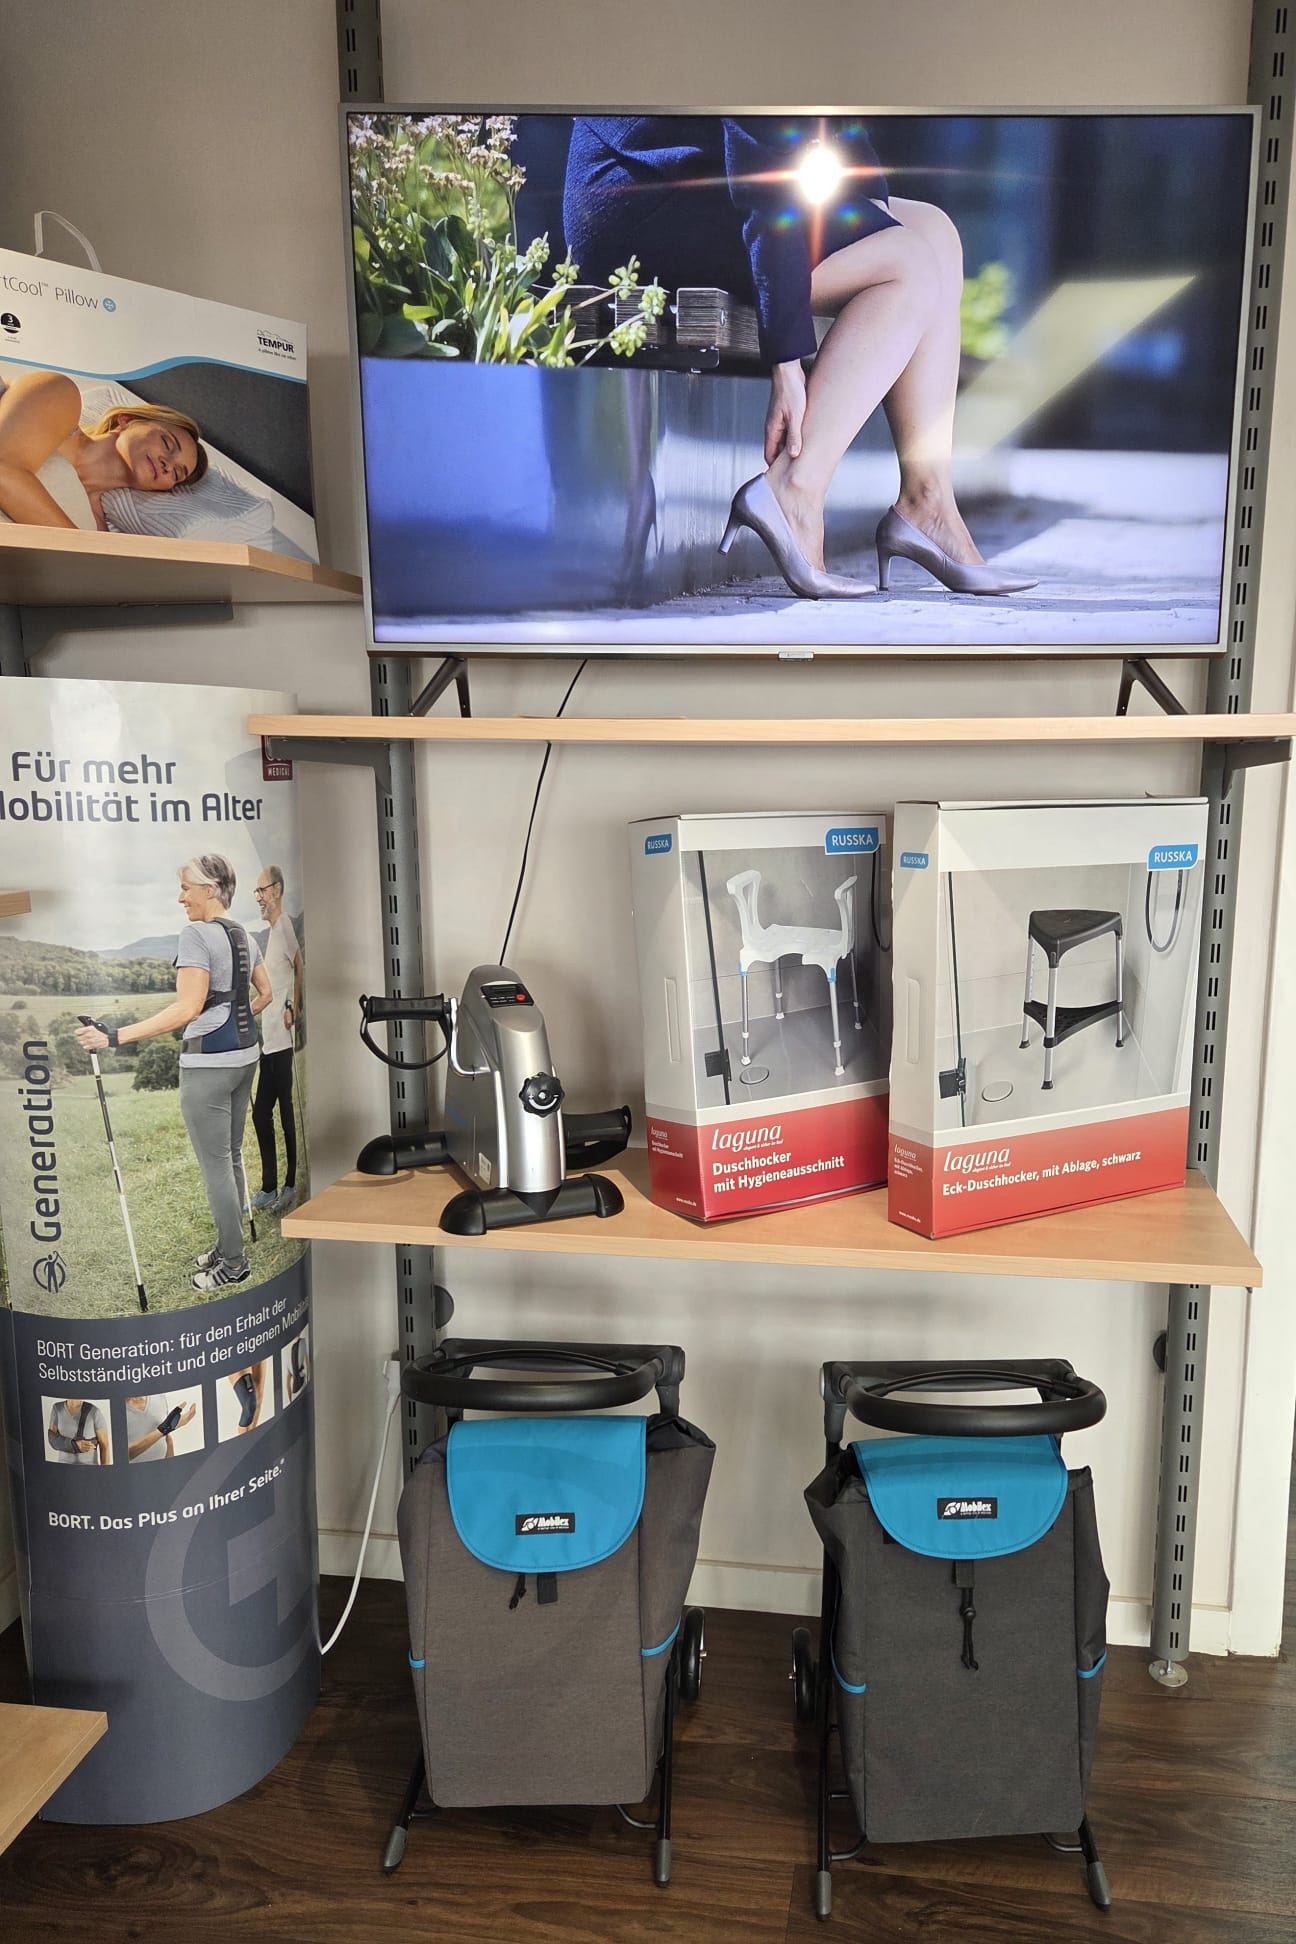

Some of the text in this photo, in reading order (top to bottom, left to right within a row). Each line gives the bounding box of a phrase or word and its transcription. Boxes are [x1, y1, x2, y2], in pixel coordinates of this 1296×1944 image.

[55, 287, 98, 309] Pillow
[257, 336, 295, 353] TEMPUR
[11, 751, 177, 785] Für mehr
[0, 790, 263, 822] obilität im Alter
[647, 839, 670, 850] RUSSKA
[831, 834, 874, 847] RUSSKA
[903, 854, 926, 865] RUSSKA
[1153, 850, 1193, 863] RUSSKA
[18, 1040, 62, 1242] Generation
[711, 1124, 782, 1153] laguna
[712, 1152, 792, 1176] Duschhocker
[713, 1155, 845, 1193] mit Hygieneausschnitt
[942, 1150, 1142, 1197] Eck-Duschhocker, mit Ablage, schwarz
[943, 1147, 1011, 1174] laguna
[37, 1298, 287, 1360] BORT Generation: für den Erhalt der
[39, 1360, 173, 1384] Selbstständigkeit
[177, 1350, 206, 1373] und
[210, 1347, 234, 1364] der
[236, 1324, 281, 1355] eigenen
[48, 1511, 96, 1531] BORT.
[99, 1515, 134, 1531] Das
[138, 1509, 178, 1528] Plus
[182, 1502, 205, 1519] an
[209, 1486, 246, 1511] Ihrer
